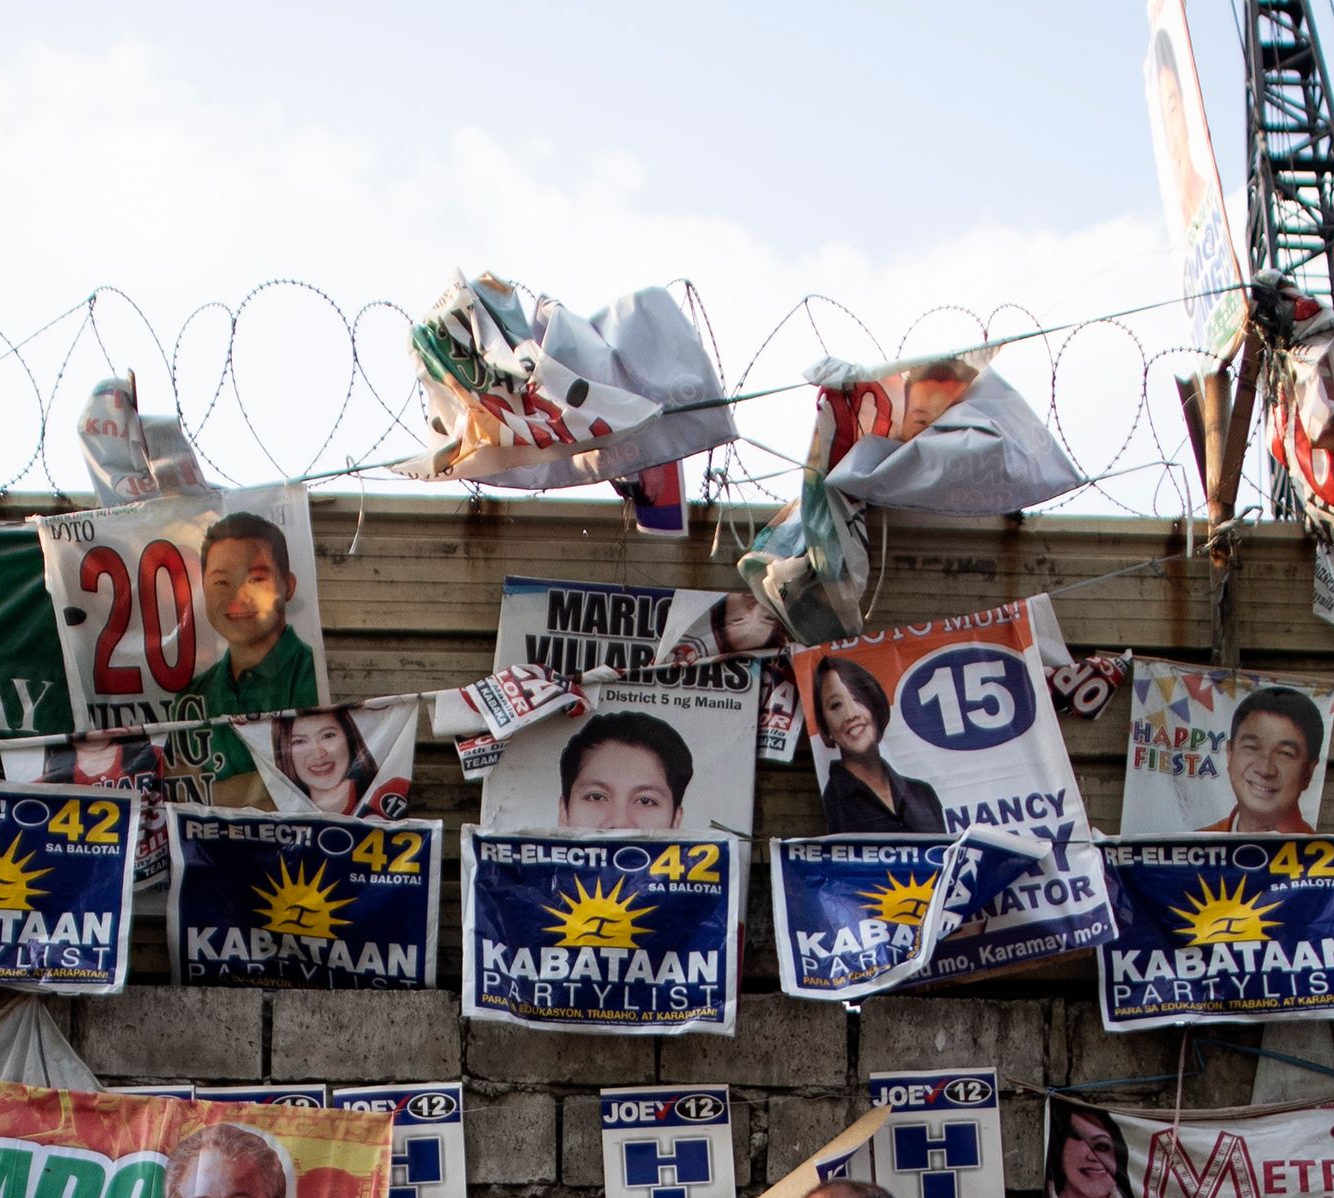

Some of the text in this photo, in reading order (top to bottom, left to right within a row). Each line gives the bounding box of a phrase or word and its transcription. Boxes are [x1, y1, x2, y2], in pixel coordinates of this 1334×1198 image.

[79, 539, 197, 696] 20
[607, 690, 743, 711] District 5 ng Manila
[918, 660, 1017, 737] 15
[1132, 719, 1227, 753] HAPPY
[1133, 747, 1218, 778] FIESTA
[47, 800, 122, 845] 42
[385, 796, 406, 818] 17
[945, 789, 1066, 833] NANCY
[186, 821, 423, 874] RE-ELECT! 42
[480, 841, 720, 885] RE-ELECT! 42
[788, 845, 919, 863] RE-ELECT!
[1105, 846, 1227, 868] RE-ELECT!
[187, 927, 418, 978] KABATAAN
[482, 939, 719, 985] KABATAAN
[979, 921, 1110, 966] Karamay mo.
[483, 971, 719, 1012] PARTYLIST
[1114, 1006, 1143, 1018] PARA
[416, 1097, 447, 1117] 12
[683, 1096, 715, 1120] 12
[873, 1080, 984, 1109] JOEY 12
